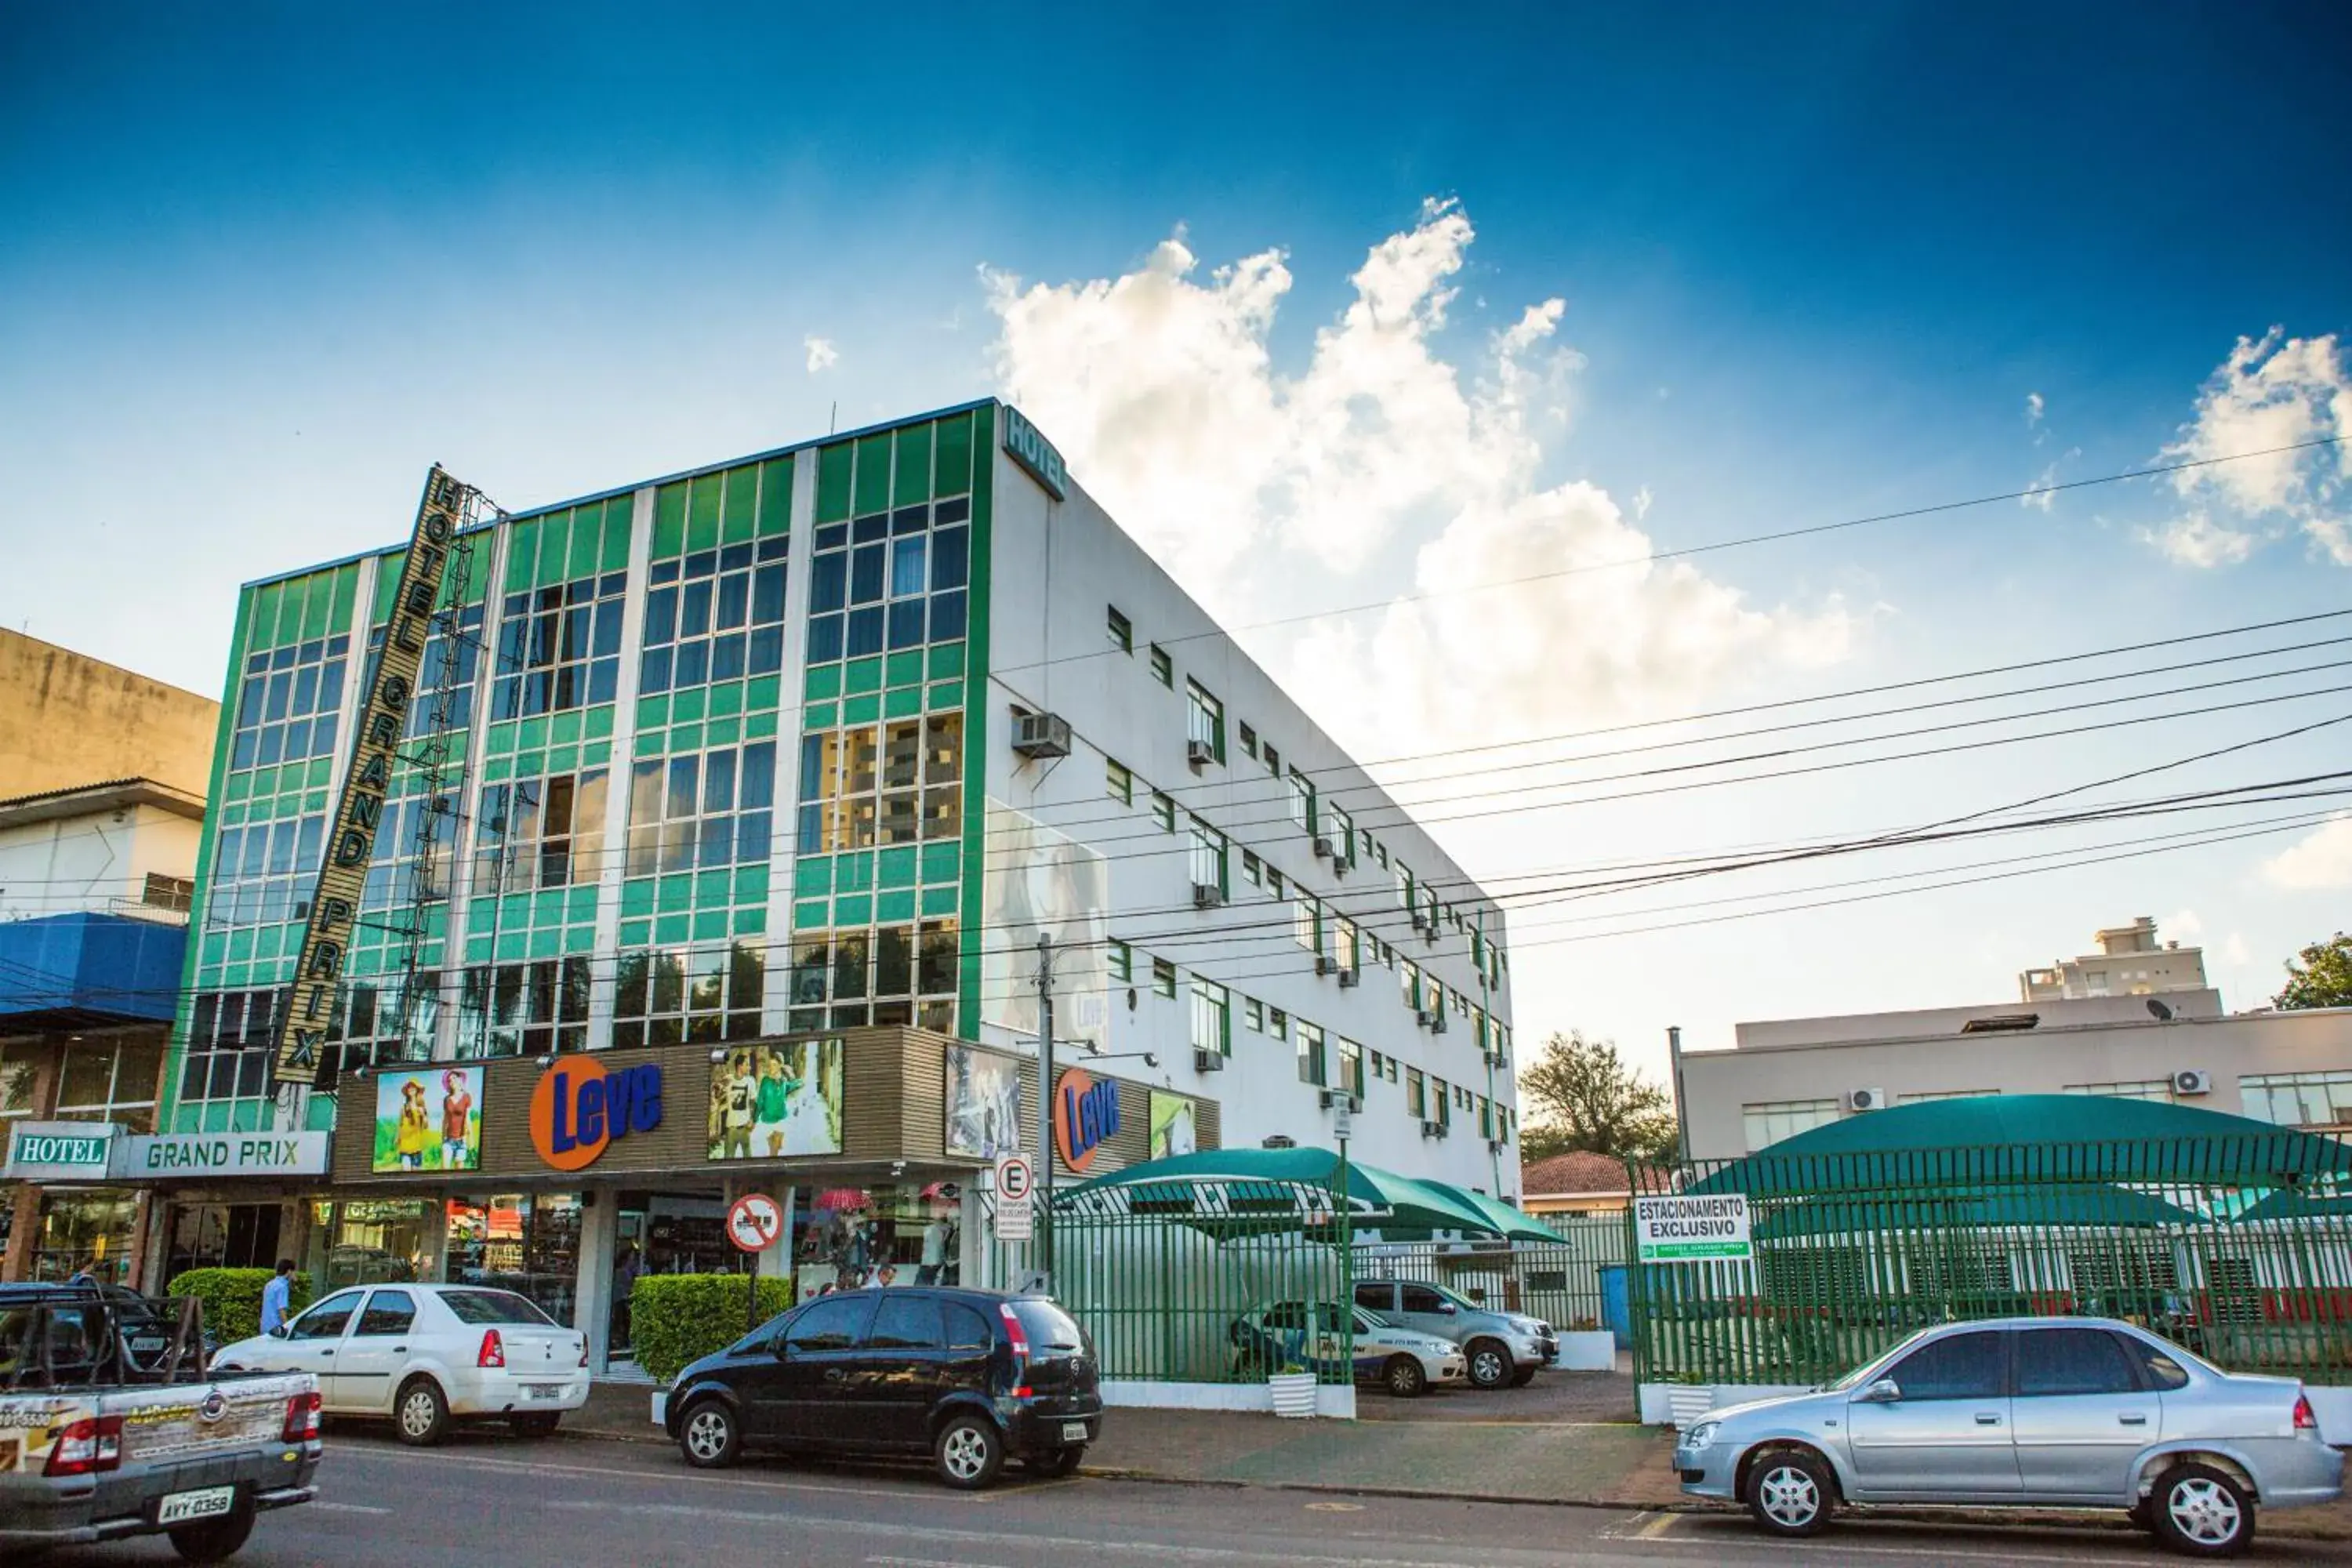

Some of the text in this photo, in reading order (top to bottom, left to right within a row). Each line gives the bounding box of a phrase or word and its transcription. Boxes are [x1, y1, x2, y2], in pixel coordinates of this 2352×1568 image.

[1009, 409, 1065, 495] HOTEL
[289, 476, 459, 1068] HOTEL GRAND PRIX
[552, 1063, 662, 1154] Leve
[1065, 1079, 1120, 1160] Leve
[21, 1137, 298, 1168] HOTEL GRAND PRIX
[1007, 1166, 1022, 1192] E
[1639, 1198, 1744, 1220] ESTACIONAMENTO
[1650, 1220, 1735, 1238] EXCLUSIVO
